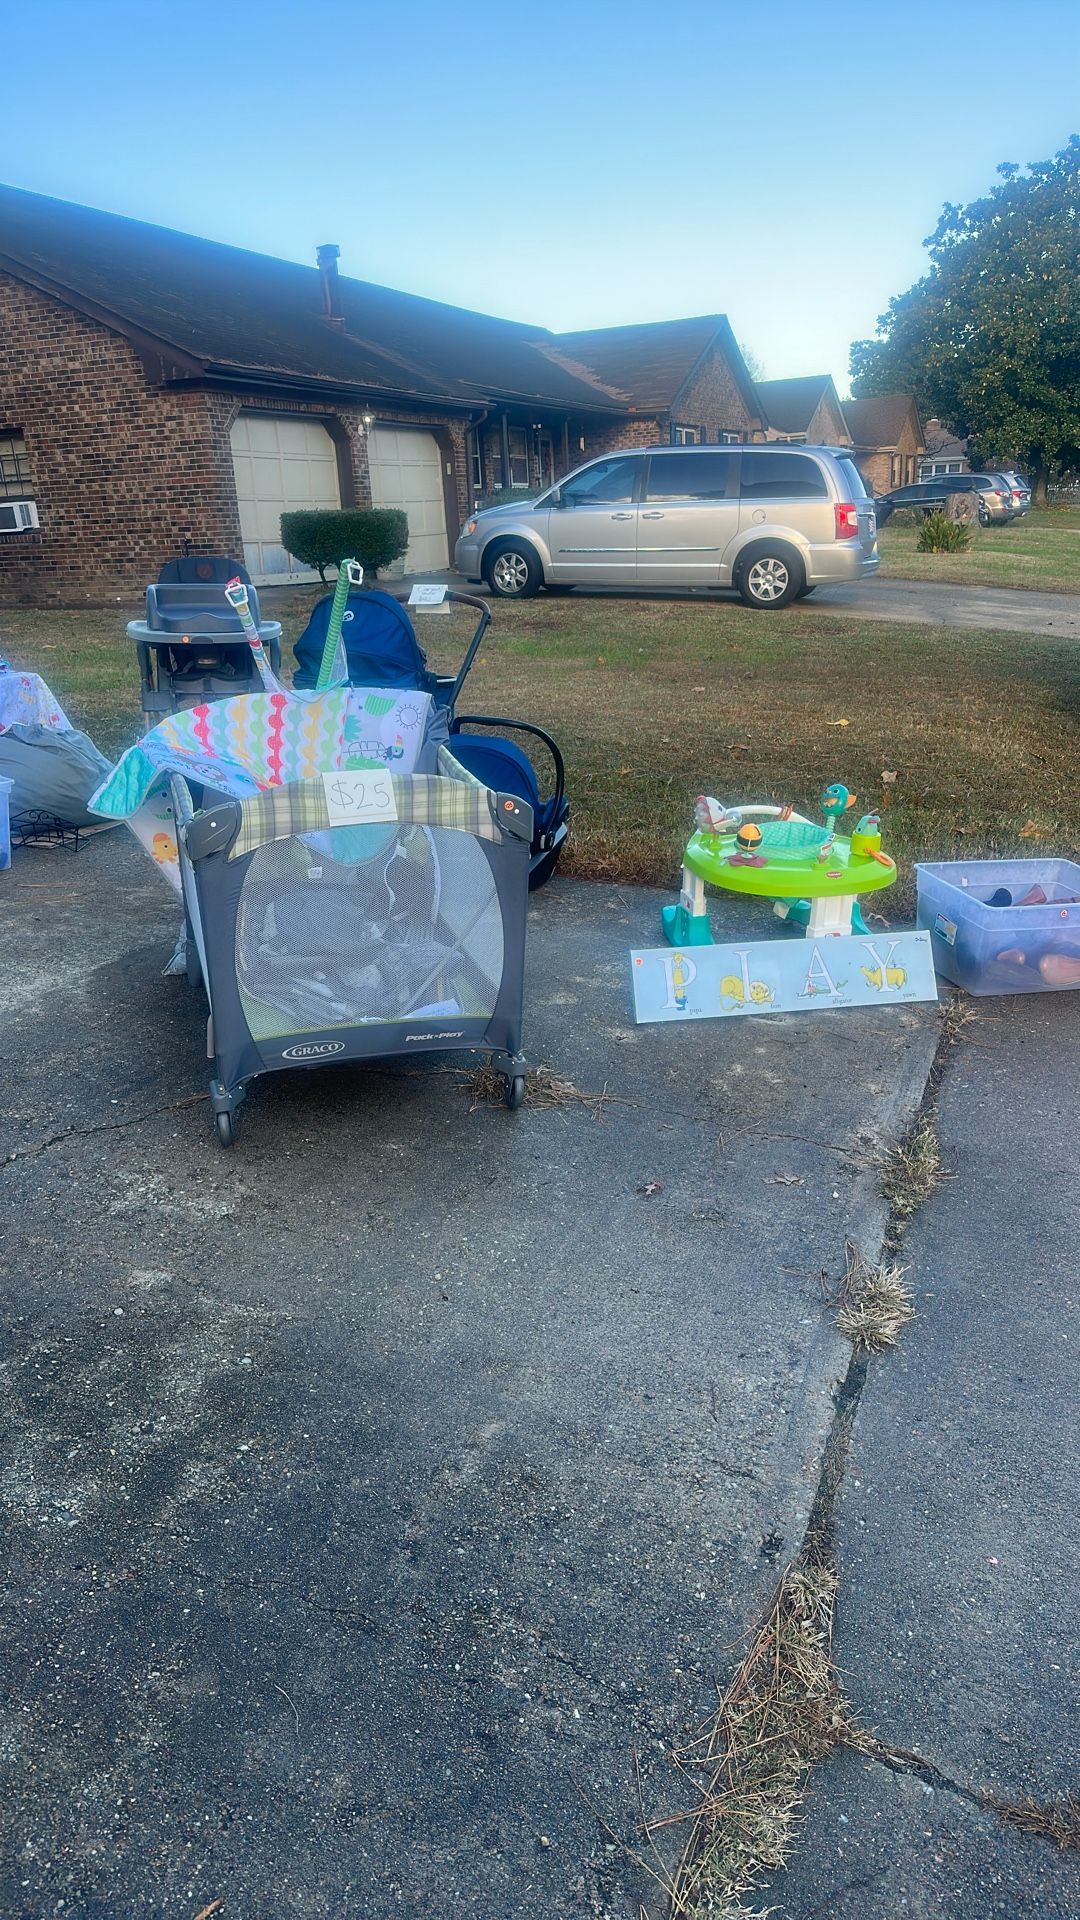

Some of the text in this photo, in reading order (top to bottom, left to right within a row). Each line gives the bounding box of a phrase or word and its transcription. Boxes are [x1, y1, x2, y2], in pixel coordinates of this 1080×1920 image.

[330, 779, 391, 810] $25
[657, 940, 902, 1009] PLAY
[405, 1033, 434, 1042] Pack
[438, 1031, 464, 1039] Play
[291, 1043, 339, 1057] GRACO
